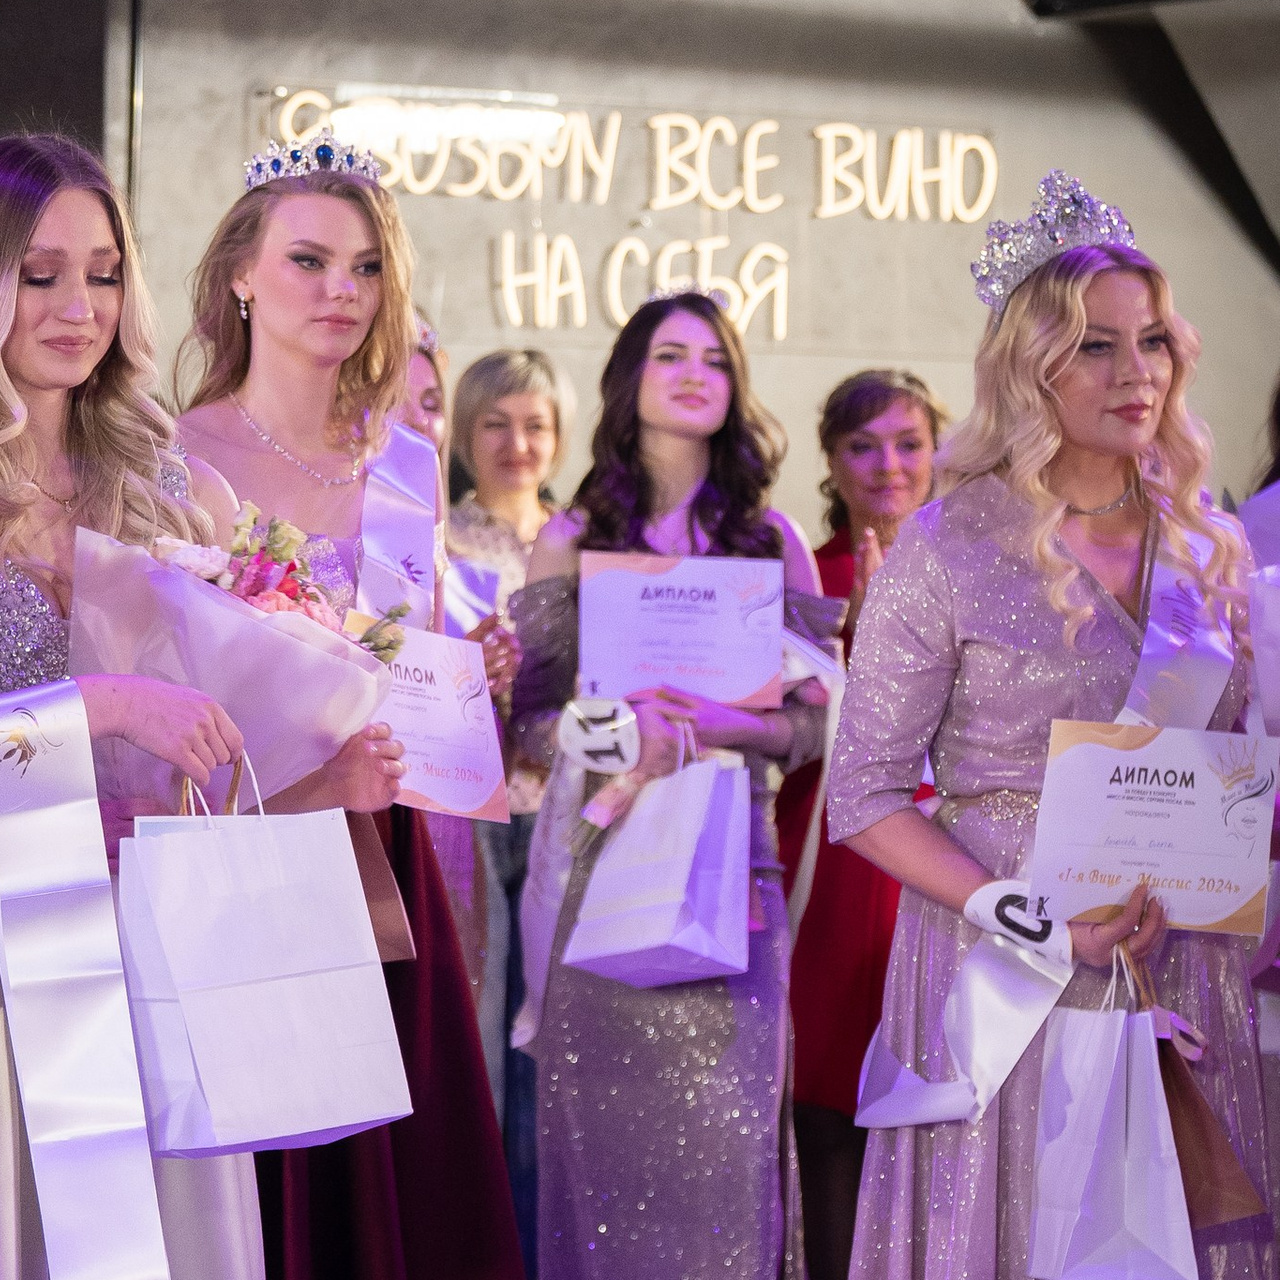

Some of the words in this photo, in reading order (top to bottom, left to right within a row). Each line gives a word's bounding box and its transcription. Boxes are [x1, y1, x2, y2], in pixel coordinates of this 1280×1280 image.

[647, 112, 784, 214] ВСЕ
[812, 122, 999, 224] ВИНО
[501, 229, 587, 329] НА
[607, 234, 790, 341] СЕБЯ
[640, 586, 717, 603] ДИПЛОМ
[577, 707, 626, 765] 11
[1109, 765, 1195, 790] ДИПЛОМ
[1089, 869, 1122, 888] Вице
[1137, 872, 1192, 890] Миссис
[1197, 876, 1240, 895] 2024»
